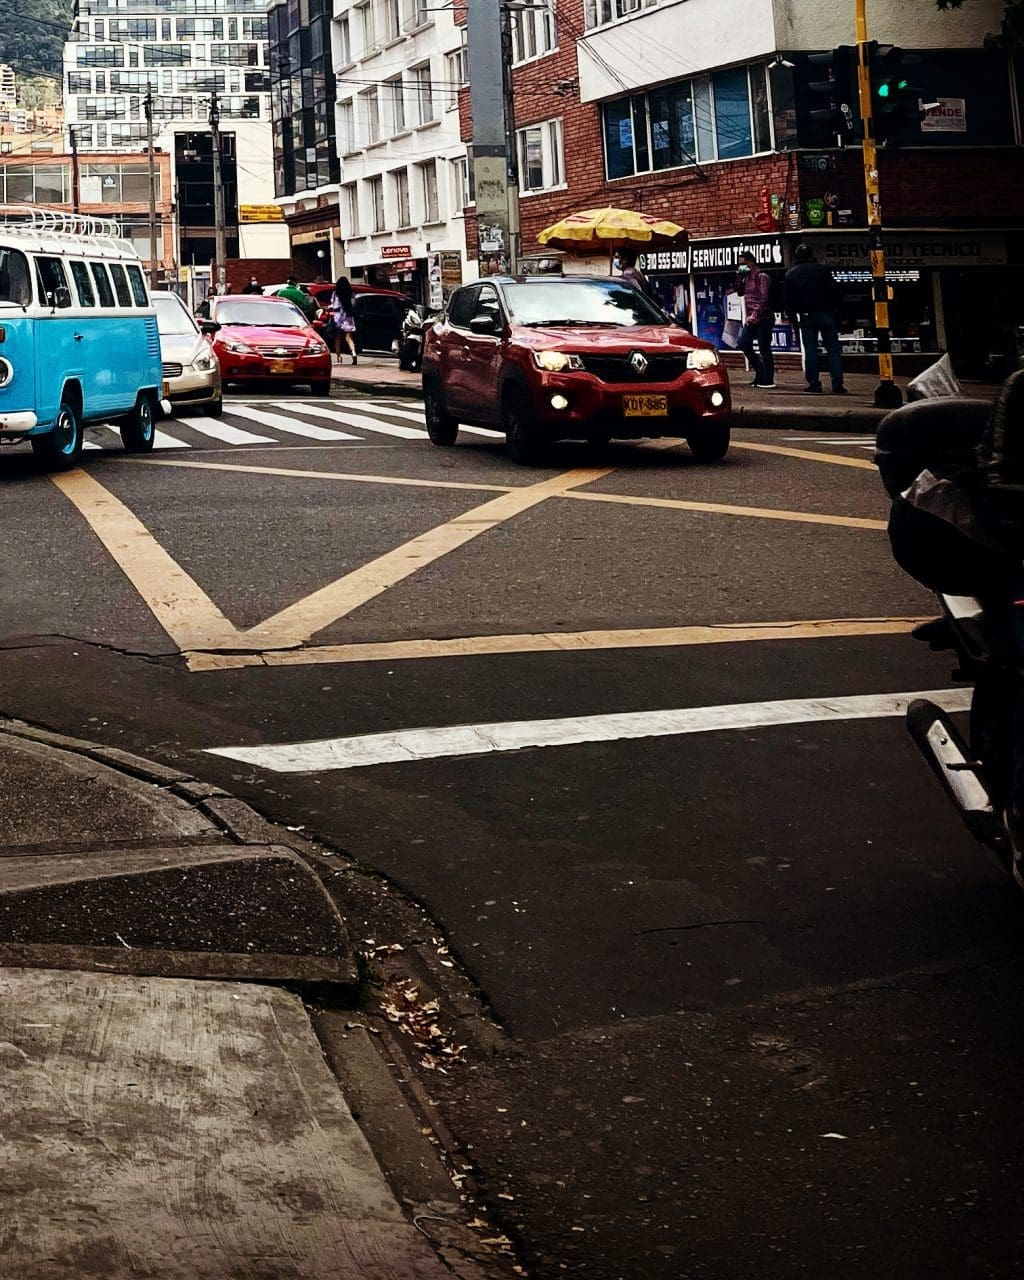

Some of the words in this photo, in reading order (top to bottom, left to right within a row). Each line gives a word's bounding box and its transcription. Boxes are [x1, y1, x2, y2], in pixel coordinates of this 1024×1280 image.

[692, 247, 732, 268] SERVICIO
[733, 242, 772, 264] TÉNICO
[826, 243, 904, 257] SERVIO
[912, 242, 981, 257] TECNICO
[658, 252, 671, 270] 555
[672, 251, 687, 269] 5010
